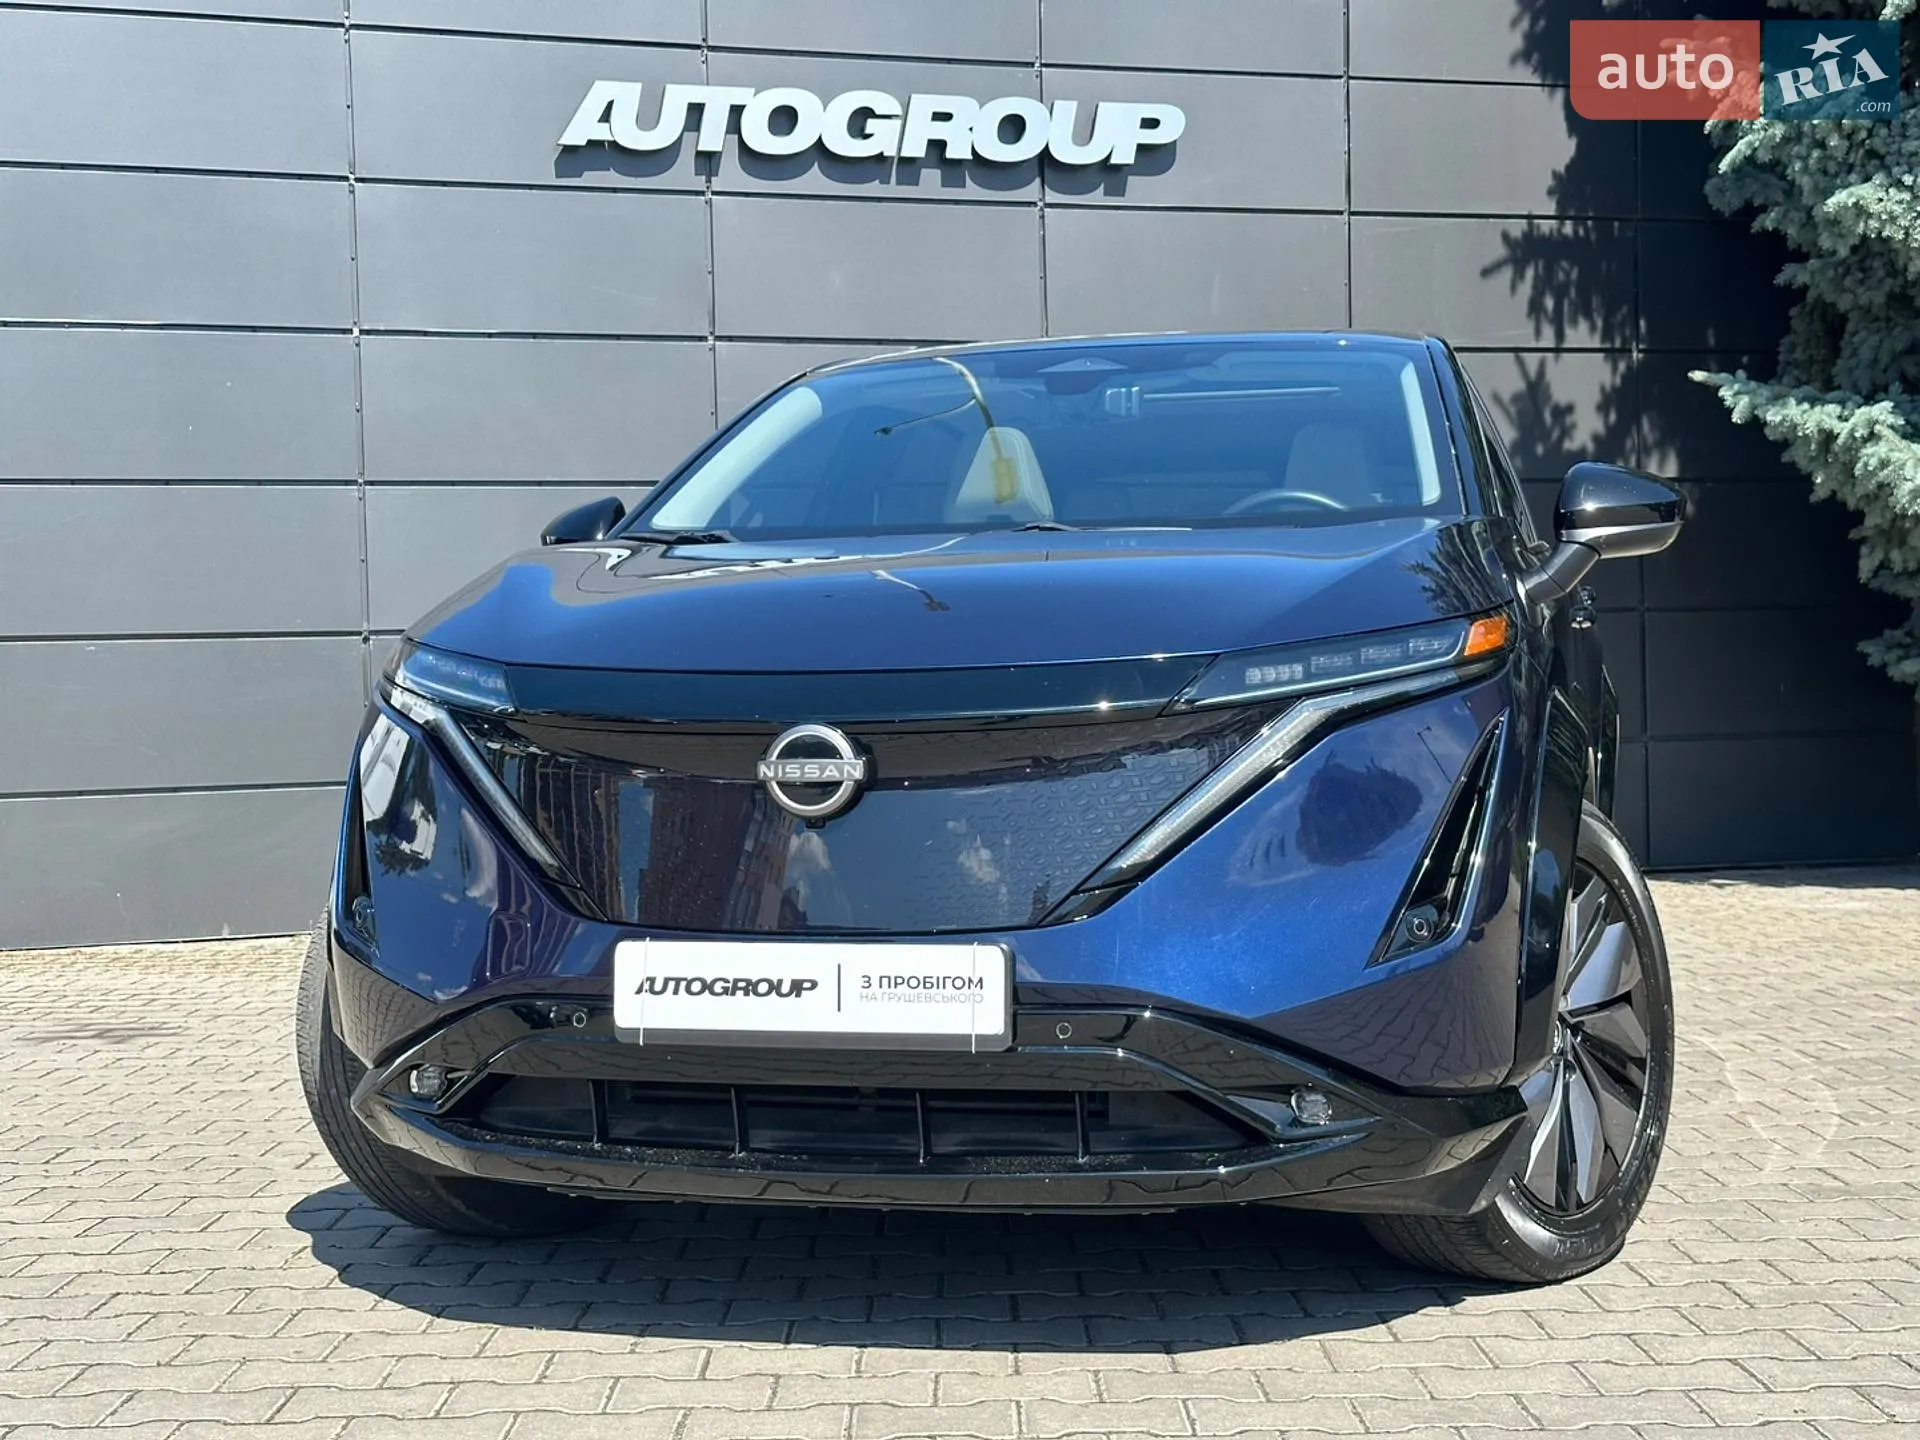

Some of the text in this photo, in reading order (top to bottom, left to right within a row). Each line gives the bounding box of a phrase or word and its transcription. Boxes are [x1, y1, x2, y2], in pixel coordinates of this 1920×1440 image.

[557, 79, 1187, 166] AUTOGROUP
[759, 764, 861, 779] NISSAN
[634, 976, 819, 998] AUTOGROUP
[860, 974, 984, 990] З ПРОБІГОМ
[860, 991, 984, 1004] НА ГРУШЕВСЬКОГО
